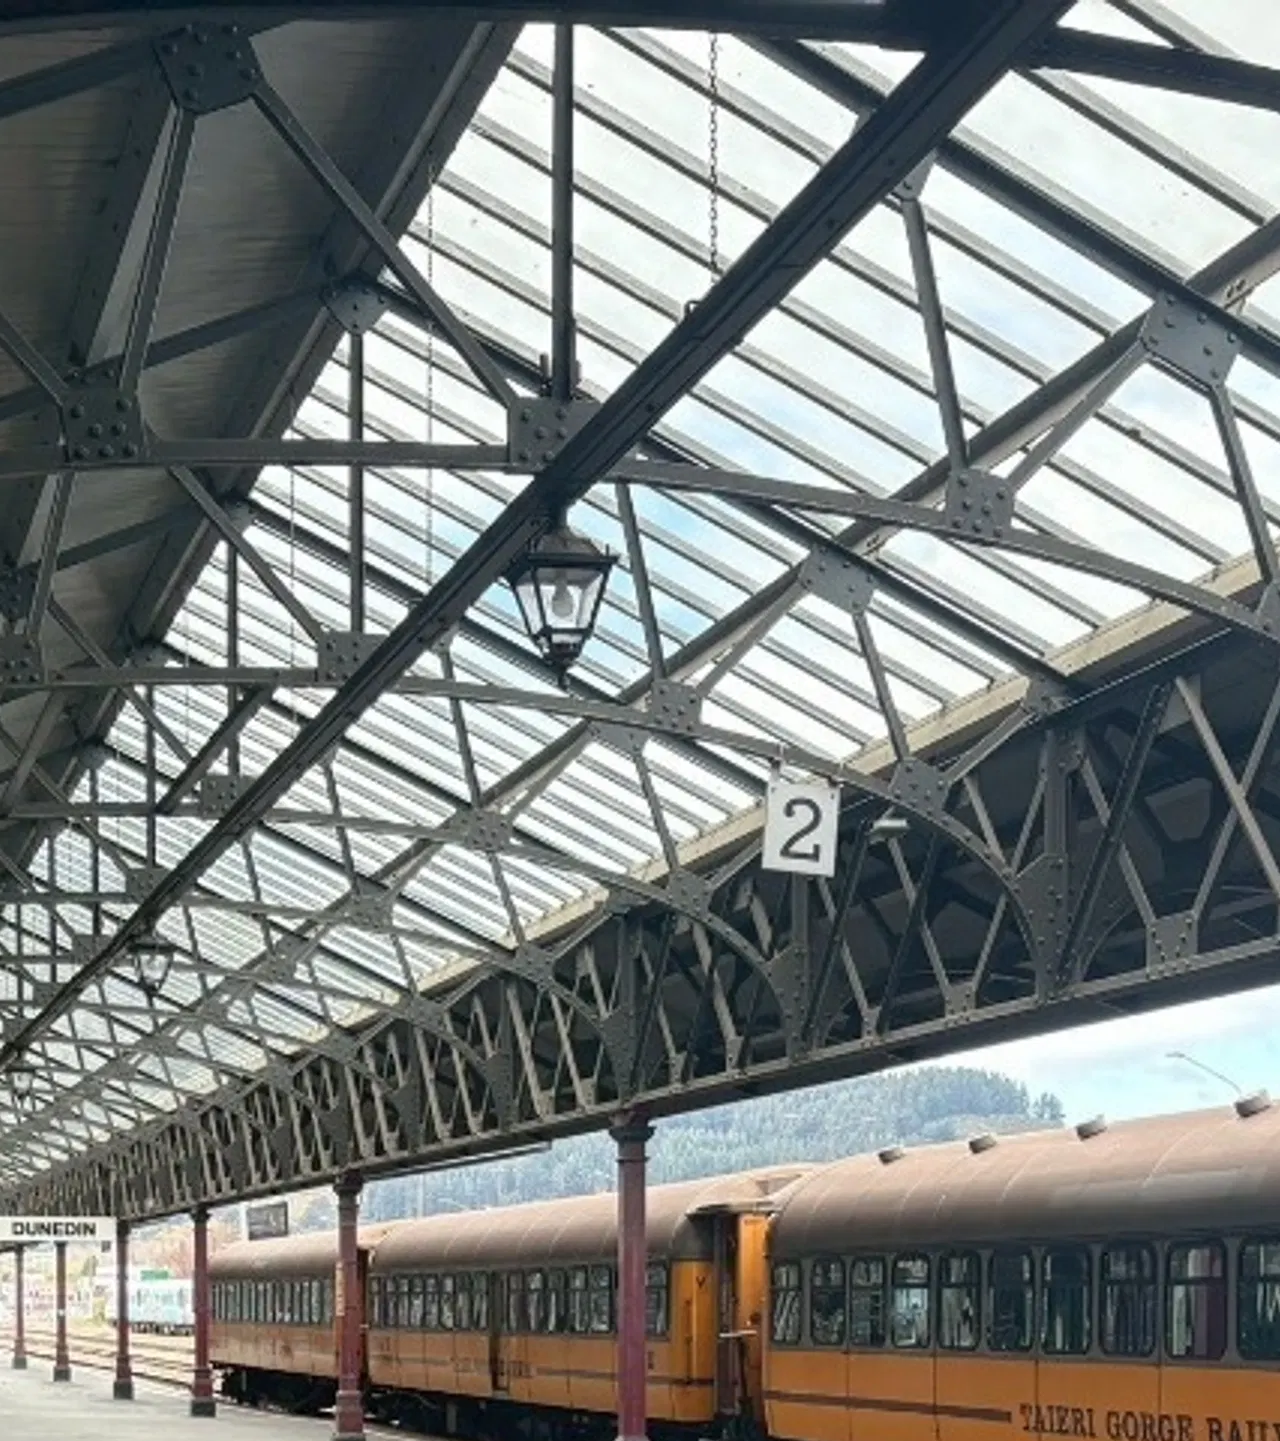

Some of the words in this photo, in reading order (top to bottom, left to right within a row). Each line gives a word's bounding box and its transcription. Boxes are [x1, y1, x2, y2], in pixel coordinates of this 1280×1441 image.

[780, 797, 822, 862] 2
[11, 1221, 96, 1236] DUNEDIN
[1019, 1403, 1097, 1439] TAIERI
